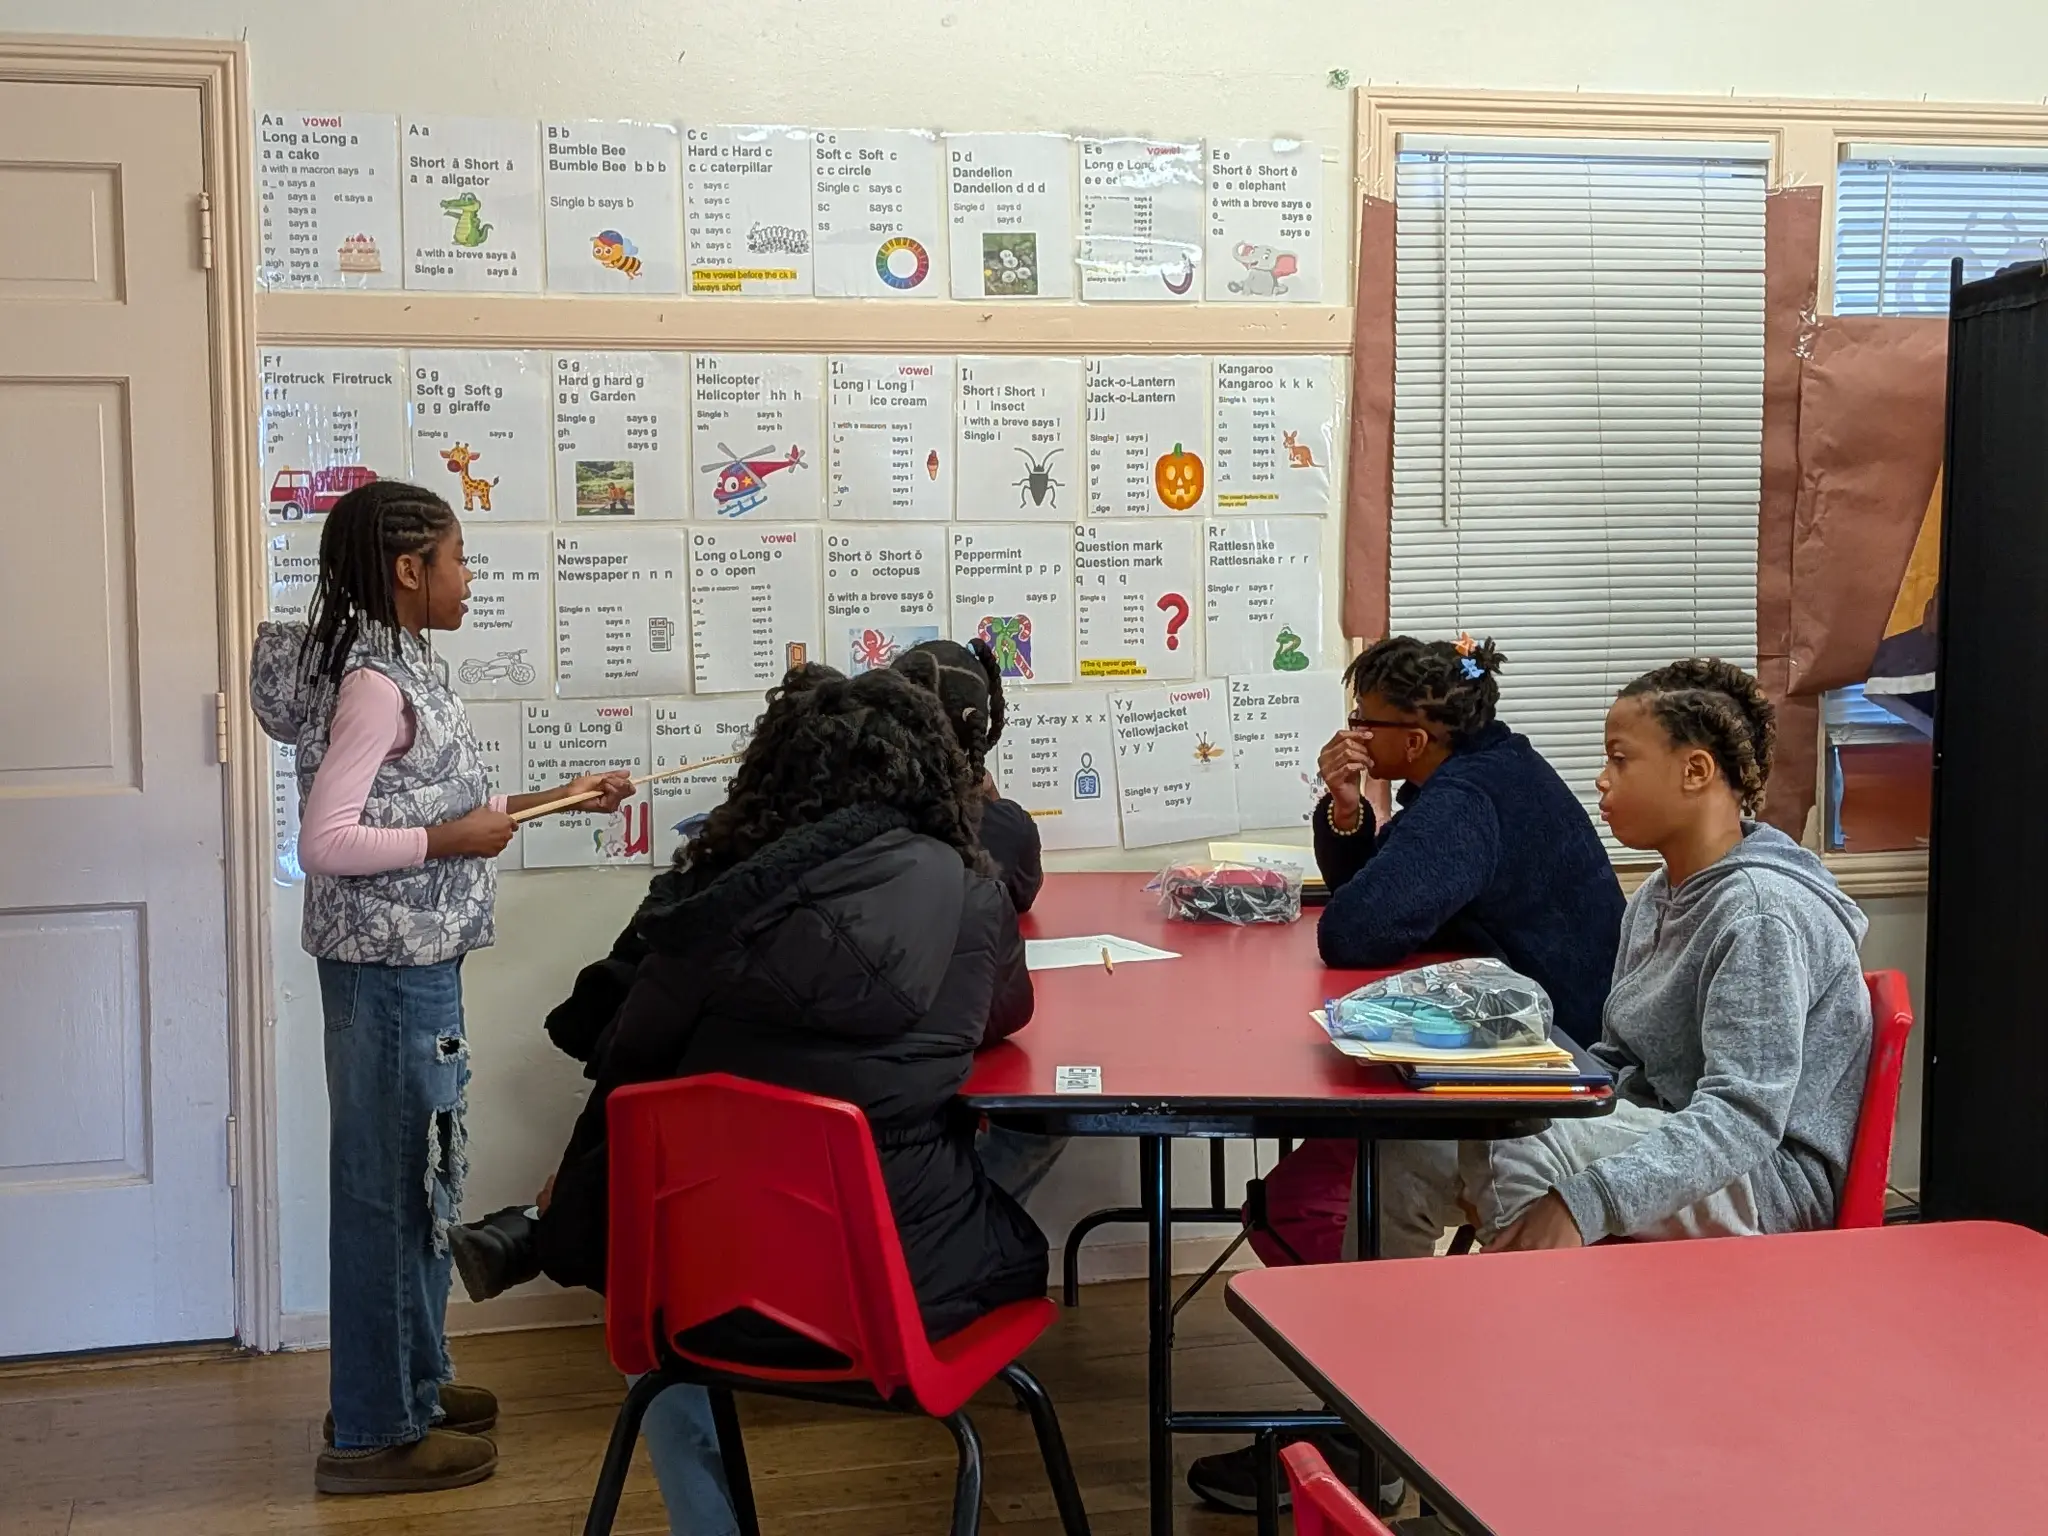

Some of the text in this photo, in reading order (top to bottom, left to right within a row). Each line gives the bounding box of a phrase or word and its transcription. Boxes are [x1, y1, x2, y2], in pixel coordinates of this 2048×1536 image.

[303, 116, 341, 127] vowel
[548, 127, 569, 138] B b
[263, 131, 346, 147] Long Long
[288, 148, 319, 160] cake
[549, 143, 625, 155] Bumble Bee
[688, 145, 761, 156] Hard Hard
[817, 149, 883, 160] Soft Soft
[1147, 146, 1180, 156] vowel
[952, 152, 972, 162] D d
[270, 164, 288, 173] with
[410, 156, 499, 170] Short Short
[549, 160, 626, 171] Bumble Bee
[711, 162, 772, 175] caterpillar
[1085, 159, 1113, 172] Long
[838, 165, 871, 175] circle
[953, 167, 1012, 177] Dandelion
[1213, 165, 1288, 176] Short Short
[442, 173, 489, 187] alligator
[817, 182, 892, 195] Single says
[954, 183, 1013, 193] Dandelion
[1239, 180, 1286, 192] elephant
[551, 196, 623, 208] Single says
[954, 203, 1014, 212] Single says
[1221, 198, 1278, 208] with breve
[818, 203, 893, 214] sc says
[870, 223, 893, 232] says
[425, 249, 483, 259] with breve
[415, 264, 509, 277] Single says
[713, 271, 736, 279] vowel
[738, 271, 763, 279] before
[693, 283, 741, 292] always short
[558, 359, 579, 372] G g
[696, 358, 716, 369] H h
[416, 368, 438, 382] G g
[899, 365, 932, 375] vowel
[1219, 364, 1273, 376] Kangaroo
[265, 372, 392, 384] Firetruck Firetruck
[559, 374, 632, 385] Hard hard
[697, 374, 760, 387] Helicopter
[1087, 377, 1175, 387] Jack-o-Lantern
[417, 384, 491, 396] Soft Soft
[834, 379, 907, 393] Long Long
[1219, 378, 1273, 391] Kangaroo
[590, 391, 635, 401] Garden
[697, 390, 760, 402] Helicopter
[963, 385, 1035, 397] Short Short
[870, 395, 927, 406] ice cream
[1087, 393, 1175, 403] Jack-o-Lantern
[1219, 396, 1240, 404] Single
[449, 402, 490, 414] giraffe
[991, 401, 1024, 411] insect
[557, 414, 648, 424] Single says
[697, 410, 721, 419] Single
[970, 417, 1028, 426] with breve
[418, 430, 441, 438] Single
[964, 431, 1054, 443] Single says
[1090, 434, 1114, 443] Single
[1209, 527, 1226, 536] R r
[761, 532, 796, 543] vowel
[557, 539, 578, 549] N n
[1074, 540, 1162, 552] Question mark
[695, 549, 770, 563] Long Long
[829, 550, 911, 562] Short Short
[955, 548, 1021, 562] Peppermint
[1210, 555, 1274, 566] Rattlesnake
[275, 556, 320, 567] Lemon
[558, 555, 628, 567] Newspaper
[1074, 556, 1162, 568] Question mark
[725, 567, 755, 576] open
[873, 567, 920, 578] octopus
[956, 563, 1022, 577] Peppermint
[558, 570, 628, 582] Newspaper
[1208, 584, 1267, 593] Single says
[837, 592, 898, 601] with breve
[956, 594, 1047, 605] Single says
[275, 606, 301, 615] Single
[559, 606, 583, 614] Single
[828, 605, 923, 616] Single says
[1233, 682, 1240, 692] Z
[1170, 688, 1210, 705] (vowel)
[1233, 695, 1299, 706] Zebra Zebra
[597, 706, 632, 716] vowel
[1116, 708, 1188, 725] Yellowjacket
[1002, 715, 1067, 730] X-ray X-ray
[528, 722, 611, 735] Long Long
[656, 723, 749, 735] Short Short
[1118, 722, 1188, 738] Yellowjacket
[559, 738, 606, 748] unicorn
[1234, 733, 1258, 742] Single
[537, 759, 558, 767] with
[662, 776, 681, 784] with
[653, 788, 682, 796] Single
[1125, 783, 1183, 796] Single says
